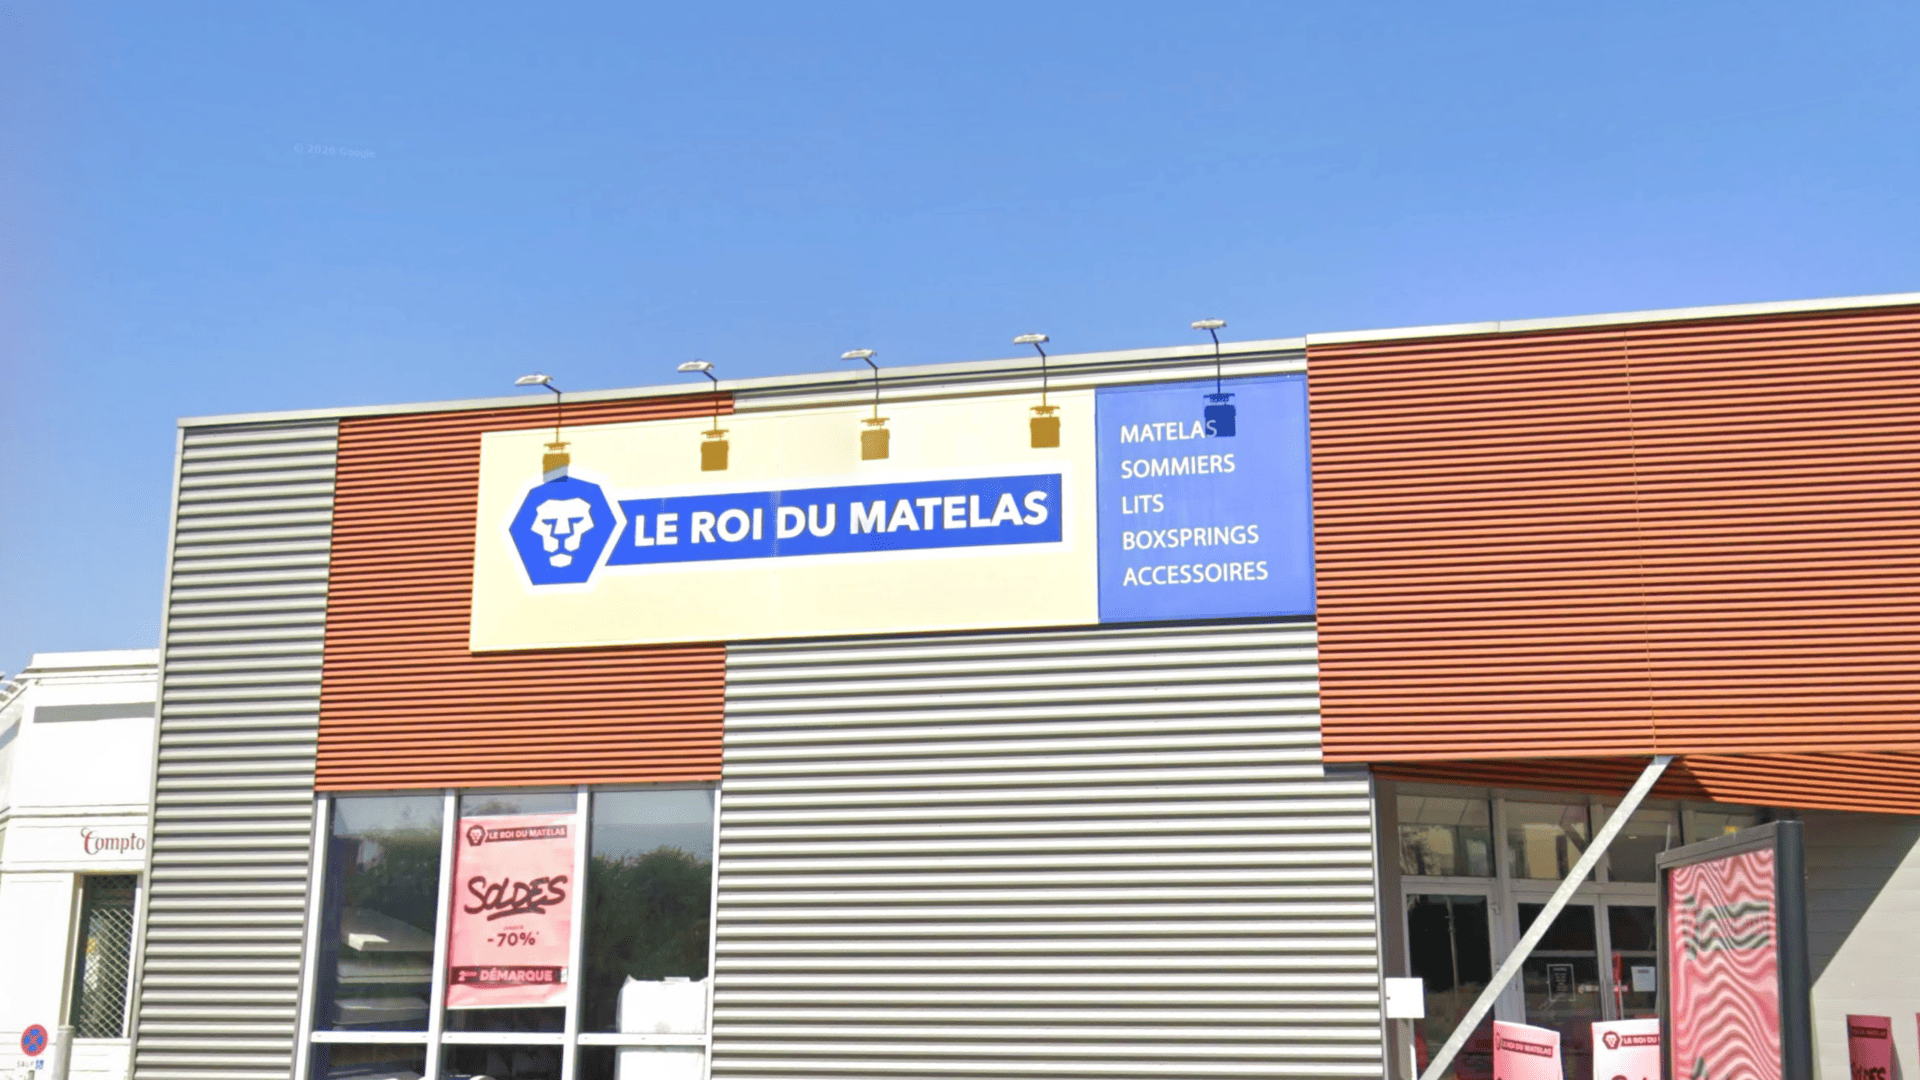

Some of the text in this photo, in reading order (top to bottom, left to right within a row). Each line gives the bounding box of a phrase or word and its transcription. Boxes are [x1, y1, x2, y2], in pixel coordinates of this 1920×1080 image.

[1120, 419, 1217, 443] MATELAS
[1121, 453, 1235, 479] SOMMIERS
[1122, 494, 1164, 514] LITS
[634, 490, 1048, 547] LE ROI DU MATELAS
[1122, 524, 1259, 551] BOXSPRINGS
[1123, 561, 1268, 587] ACCESSOIRES
[81, 828, 146, 855] Compto
[489, 827, 566, 840] LE ROI DU MATELAS
[463, 875, 568, 915] SOLDES
[480, 966, 553, 982] DÉMARQUE
